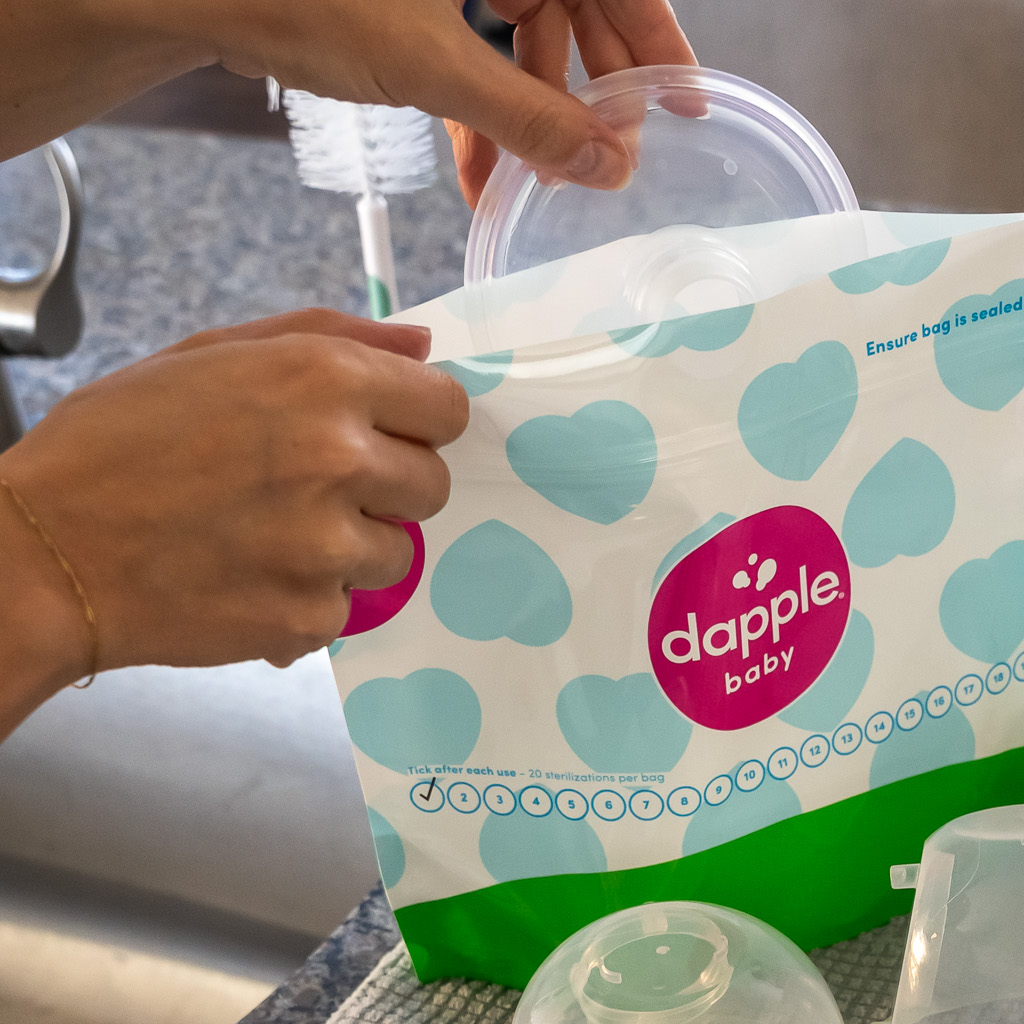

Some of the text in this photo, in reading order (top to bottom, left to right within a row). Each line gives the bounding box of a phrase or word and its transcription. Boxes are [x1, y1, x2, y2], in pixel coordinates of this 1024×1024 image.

[866, 332, 918, 356] Ensure
[921, 319, 951, 338] bag
[955, 314, 967, 327] is
[971, 297, 1023, 322] sealed
[661, 565, 841, 664] dapple
[724, 646, 794, 695] baby
[460, 793, 468, 802] 2
[496, 795, 503, 805] 3
[532, 797, 540, 806] 4
[568, 800, 576, 809] 5
[605, 800, 612, 810] 6
[642, 801, 650, 810] 7
[680, 797, 688, 806] 8
[716, 786, 722, 795] 9
[743, 770, 756, 782] 10
[777, 757, 788, 769] 11
[809, 745, 821, 757] 12
[841, 733, 853, 745] 13
[873, 722, 886, 733] 14
[904, 709, 916, 720] 15
[934, 696, 945, 708] 16
[964, 684, 975, 695] 17
[993, 672, 1004, 684] 18
[407, 765, 432, 776] Tick
[434, 765, 464, 776] after
[466, 765, 495, 777] each
[496, 769, 517, 778] use
[529, 769, 542, 779] 20
[545, 771, 615, 784] sterilizations
[618, 773, 638, 785] per
[640, 772, 665, 784] bag
